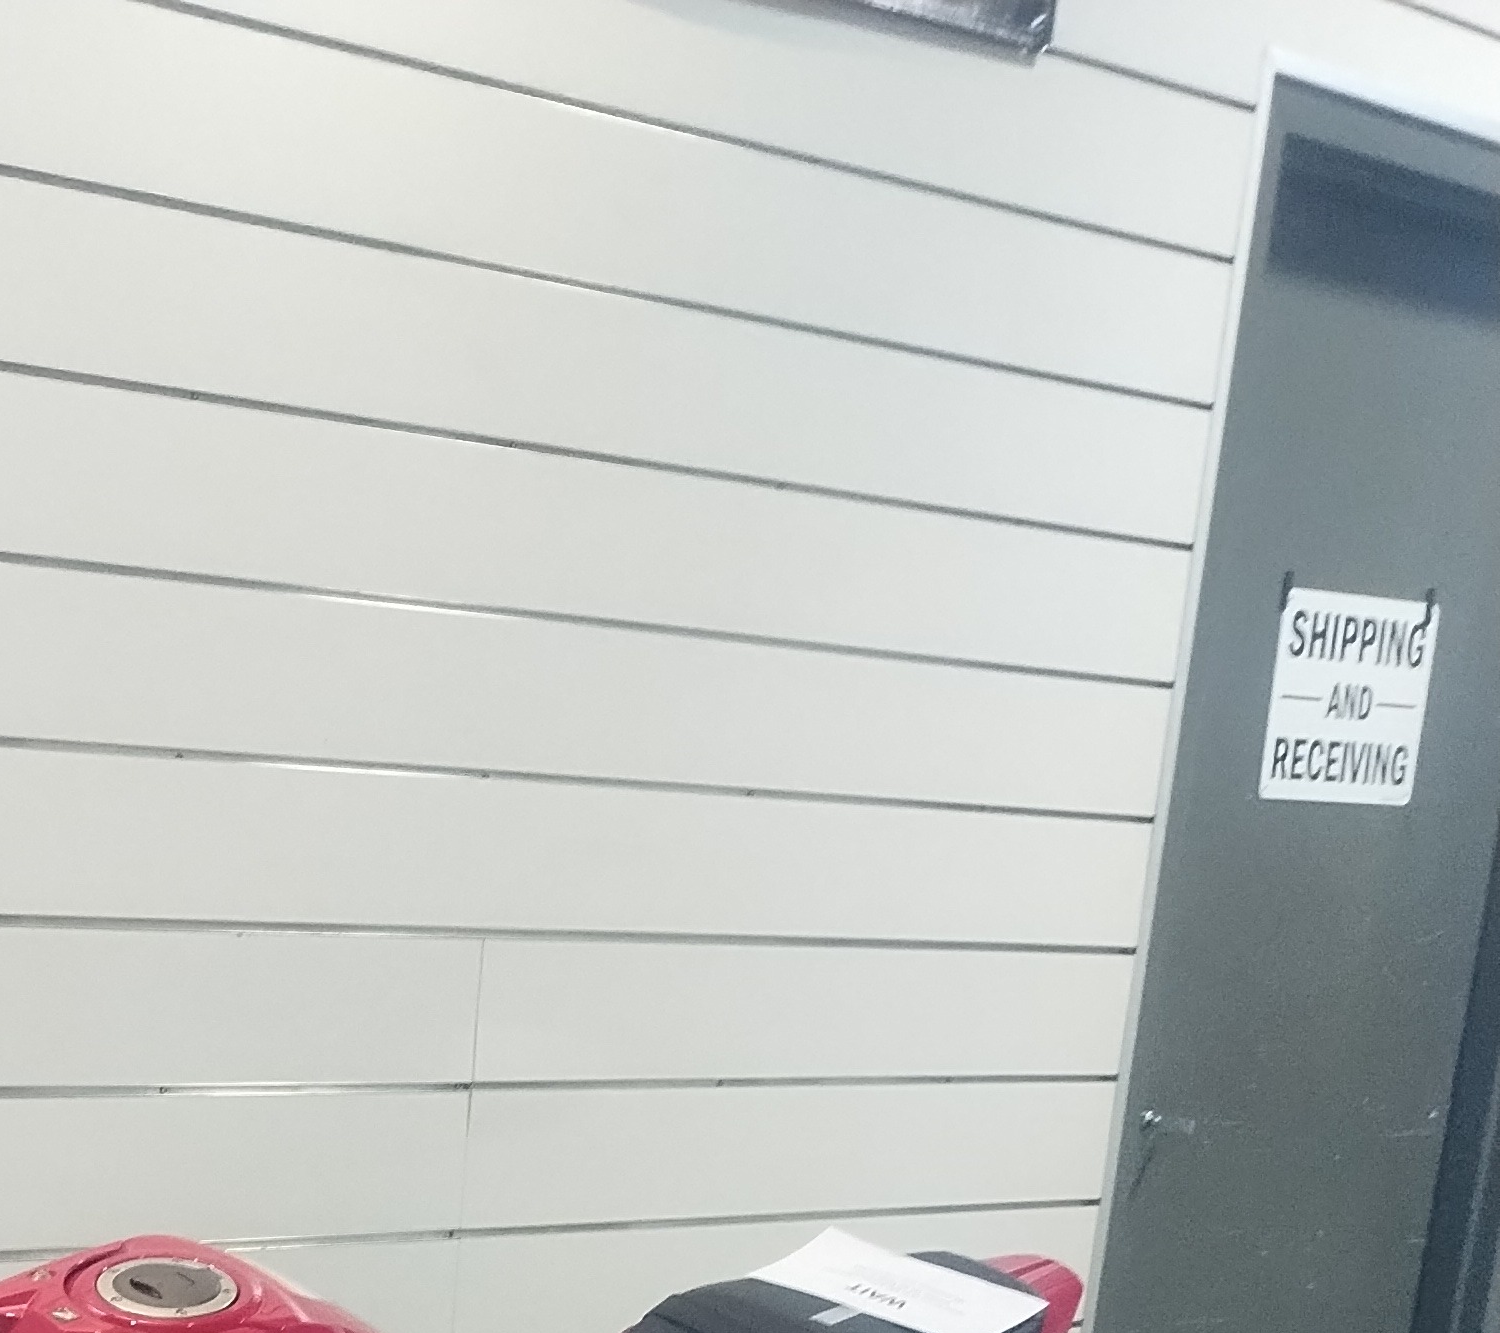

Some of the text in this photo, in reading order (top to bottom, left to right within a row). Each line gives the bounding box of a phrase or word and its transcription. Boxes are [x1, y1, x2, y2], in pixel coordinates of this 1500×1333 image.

[1289, 610, 1427, 668] SHIPPING
[1325, 682, 1373, 720] AND
[1271, 737, 1408, 785] RECEIVING
